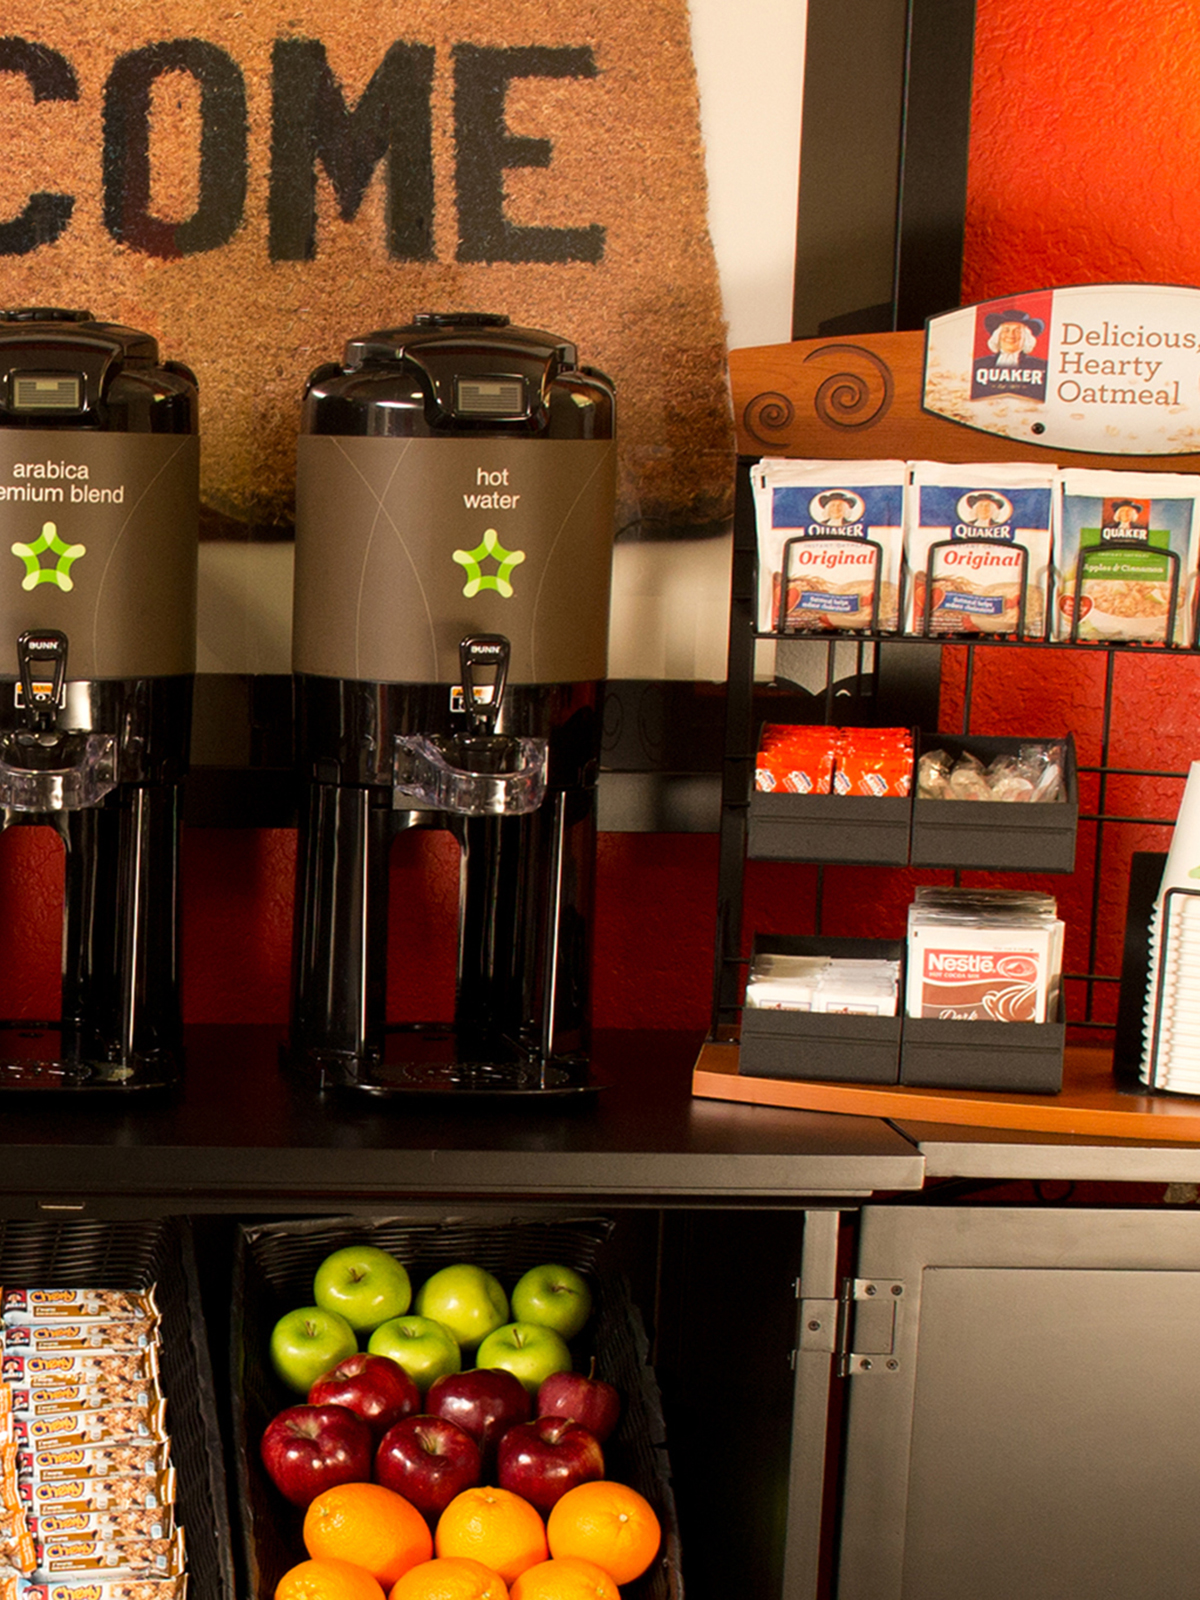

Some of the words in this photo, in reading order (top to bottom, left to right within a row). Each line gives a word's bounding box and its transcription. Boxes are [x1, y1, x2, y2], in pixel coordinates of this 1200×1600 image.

[1059, 351, 1163, 382] Hearty
[976, 368, 1043, 385] QUAKER
[1058, 380, 1181, 405] Oatmeal
[13, 460, 90, 480] arabica
[476, 467, 509, 487] hot
[70, 484, 124, 503] blend
[463, 492, 520, 510] water
[955, 524, 1011, 540] QUAKER
[1102, 527, 1148, 540] QUAKER
[798, 550, 876, 569] Original
[943, 550, 1021, 570] Original
[28, 641, 59, 650] BUNN
[470, 645, 500, 654] BUNN
[30, 1290, 77, 1303] Chewy
[33, 1326, 80, 1339] Chewy
[27, 1356, 75, 1372] Chewy
[32, 1387, 79, 1402] Chewy
[30, 1416, 78, 1436] Chewy
[36, 1450, 85, 1466] Chewy
[36, 1481, 85, 1500] Chewy
[41, 1515, 90, 1532] Chewy
[47, 1543, 96, 1558] Chewy
[52, 1585, 102, 1600] Chewy
